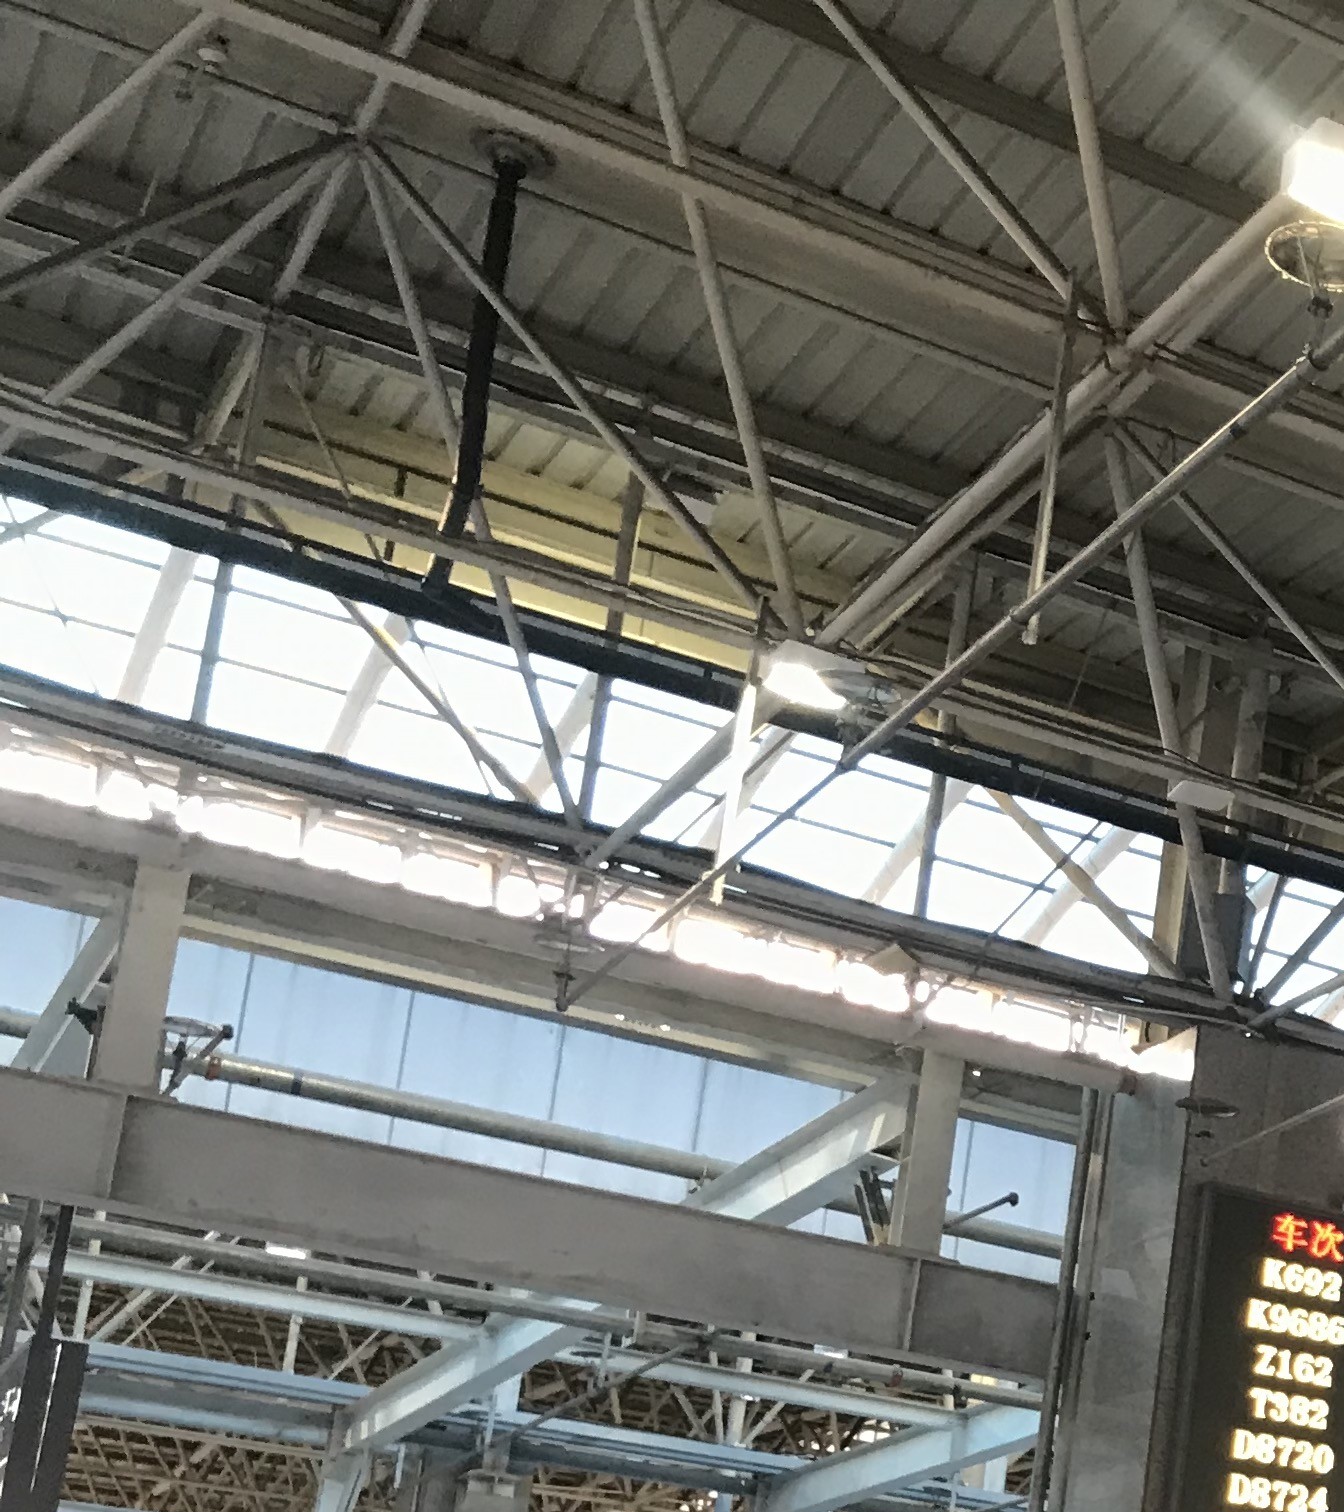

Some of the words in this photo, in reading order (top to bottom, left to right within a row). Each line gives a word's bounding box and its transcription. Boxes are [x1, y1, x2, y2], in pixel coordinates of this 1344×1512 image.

[1262, 1257, 1343, 1302] K692
[1252, 1344, 1334, 1388] Z162
[1249, 1387, 1330, 1430] T382
[1231, 1428, 1335, 1474] D8720
